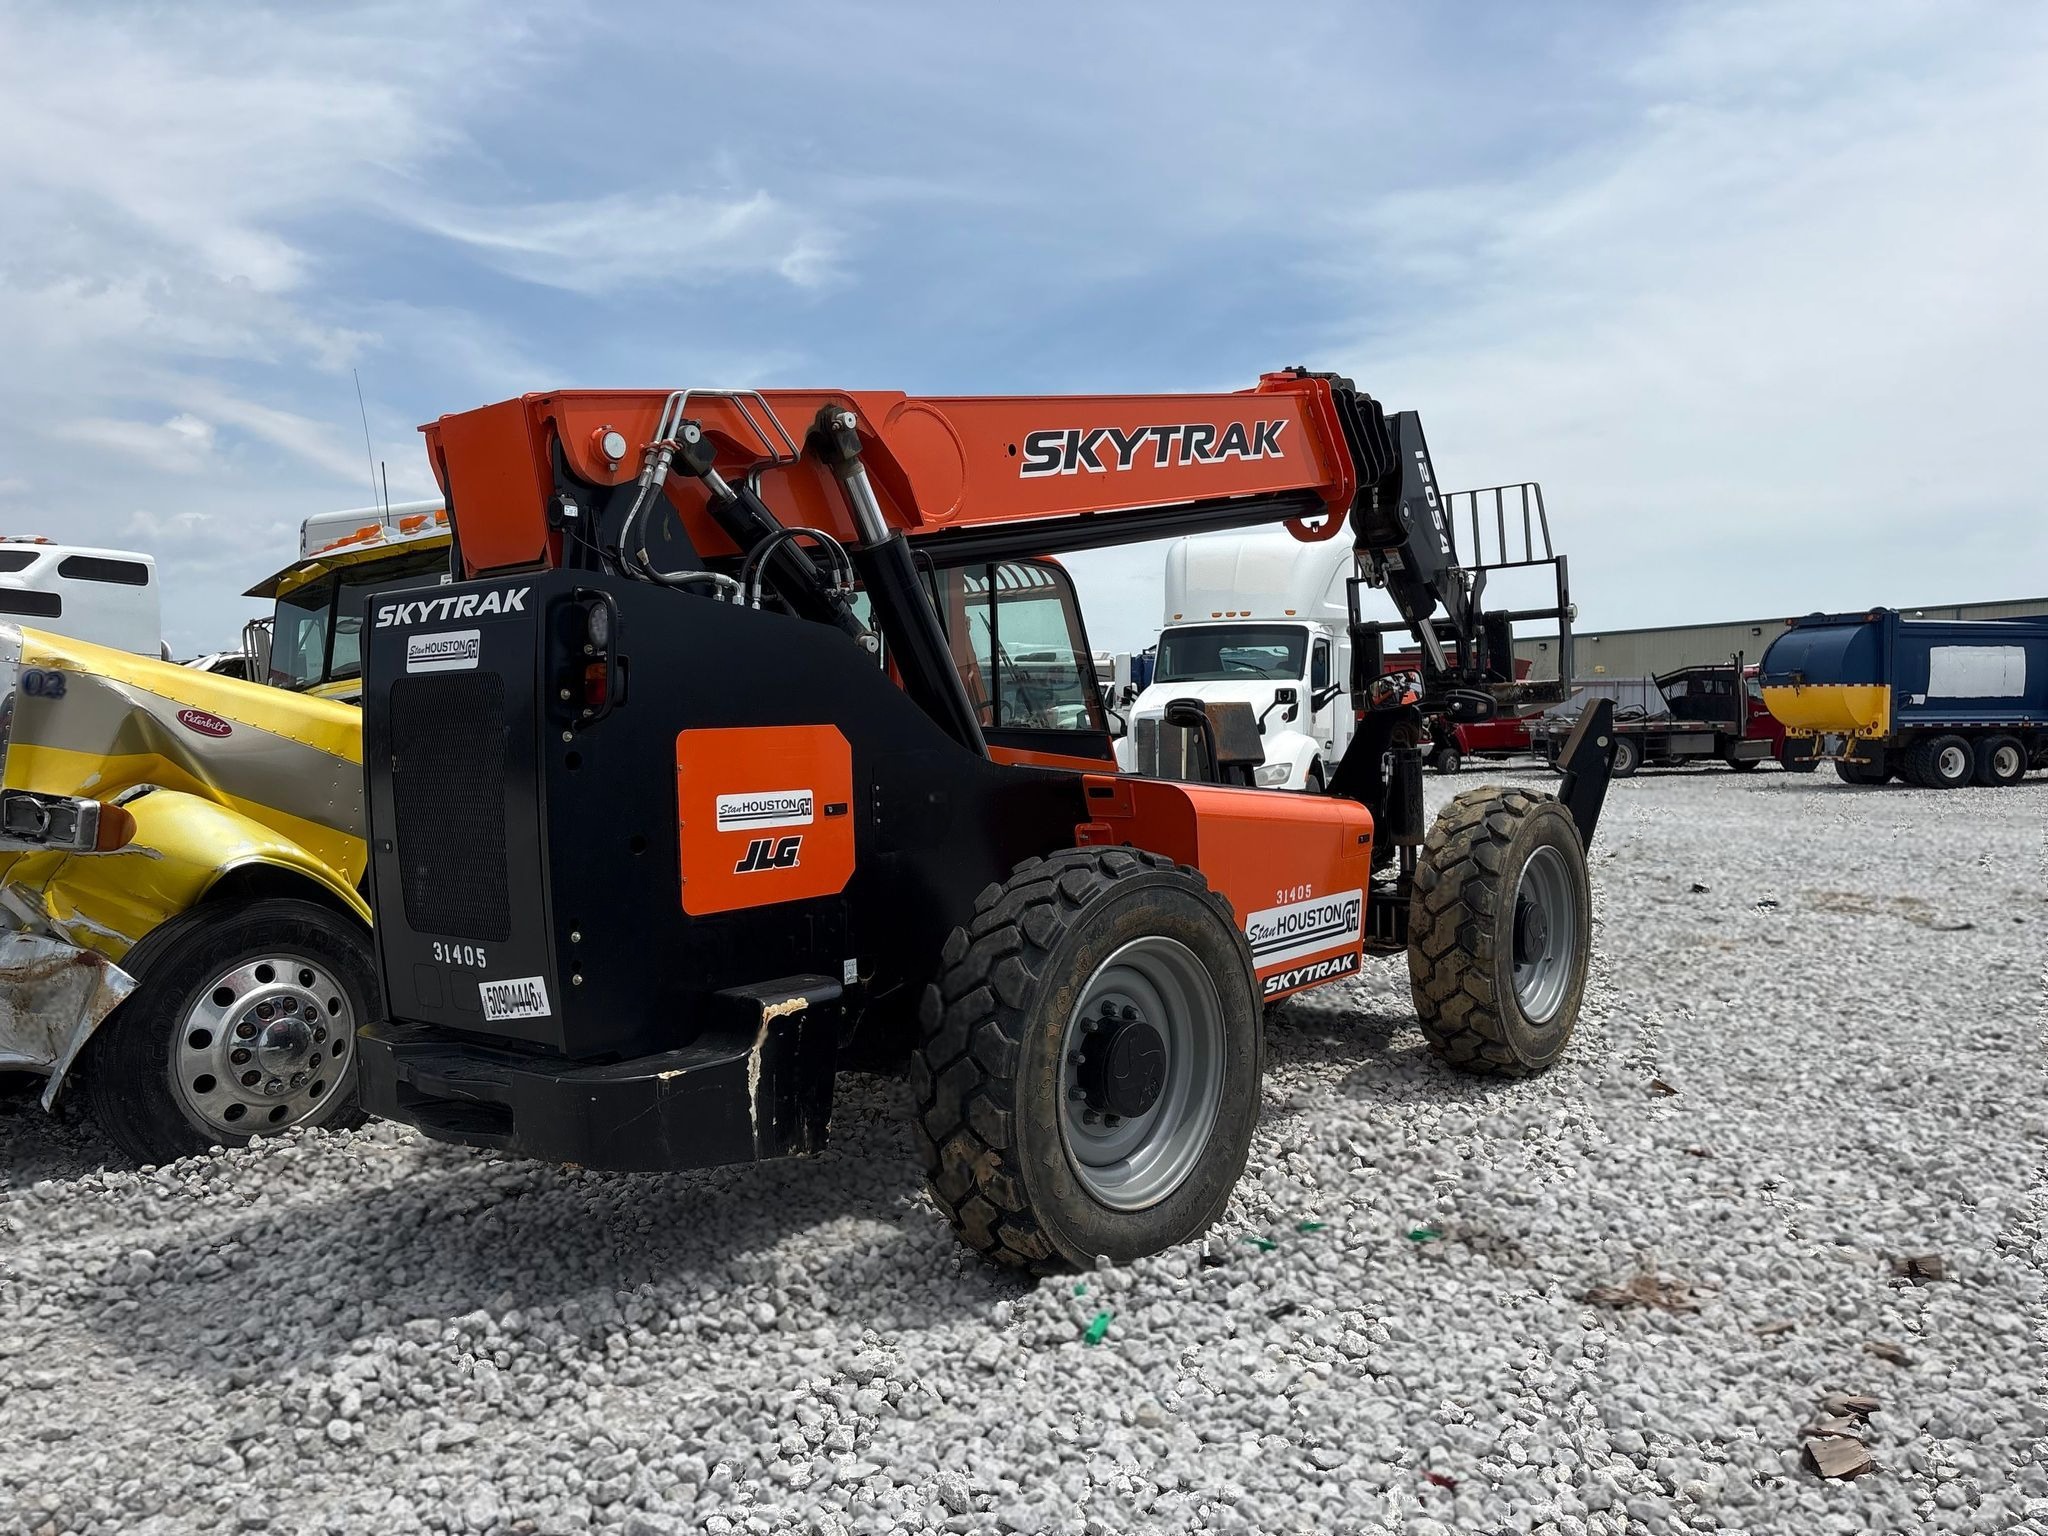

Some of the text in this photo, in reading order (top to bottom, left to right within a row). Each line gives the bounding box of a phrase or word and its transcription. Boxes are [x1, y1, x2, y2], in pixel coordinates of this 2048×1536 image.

[1019, 419, 1289, 478] SKYTRAK
[375, 587, 531, 628] SKYTRAK
[425, 640, 465, 654] HOUSTON
[183, 710, 229, 733] Peterbilt
[742, 799, 797, 813] HOUSTON
[733, 835, 804, 874] JLG
[1276, 884, 1312, 905] 31405
[1277, 903, 1342, 935] HOUSTON
[432, 941, 487, 968] 31405
[1264, 954, 1355, 995] SKYTRAK
